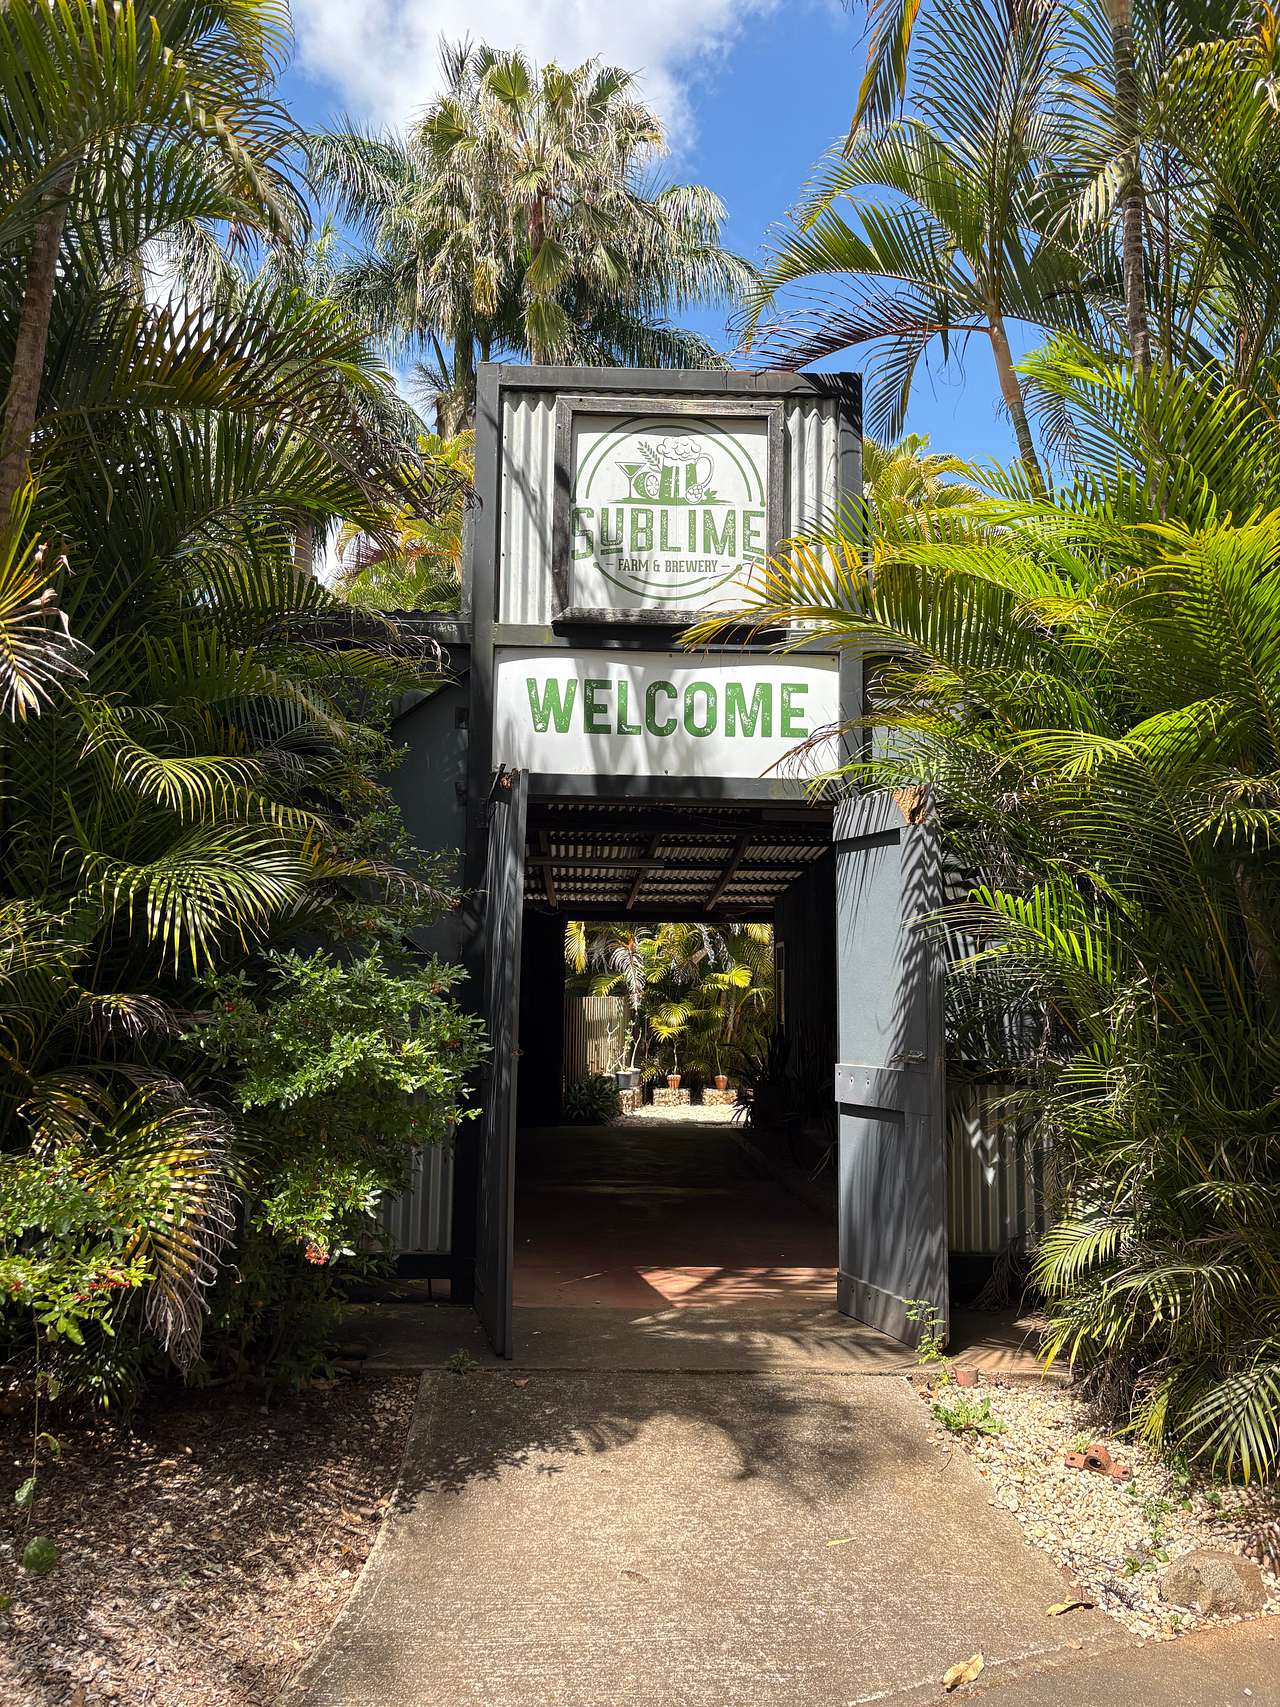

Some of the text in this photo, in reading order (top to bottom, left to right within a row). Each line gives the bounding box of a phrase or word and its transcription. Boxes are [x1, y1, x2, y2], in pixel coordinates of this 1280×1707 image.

[571, 506, 766, 563] SUBLIME
[617, 558, 719, 574] FARM & BREWERY
[526, 677, 809, 738] WELCOME
